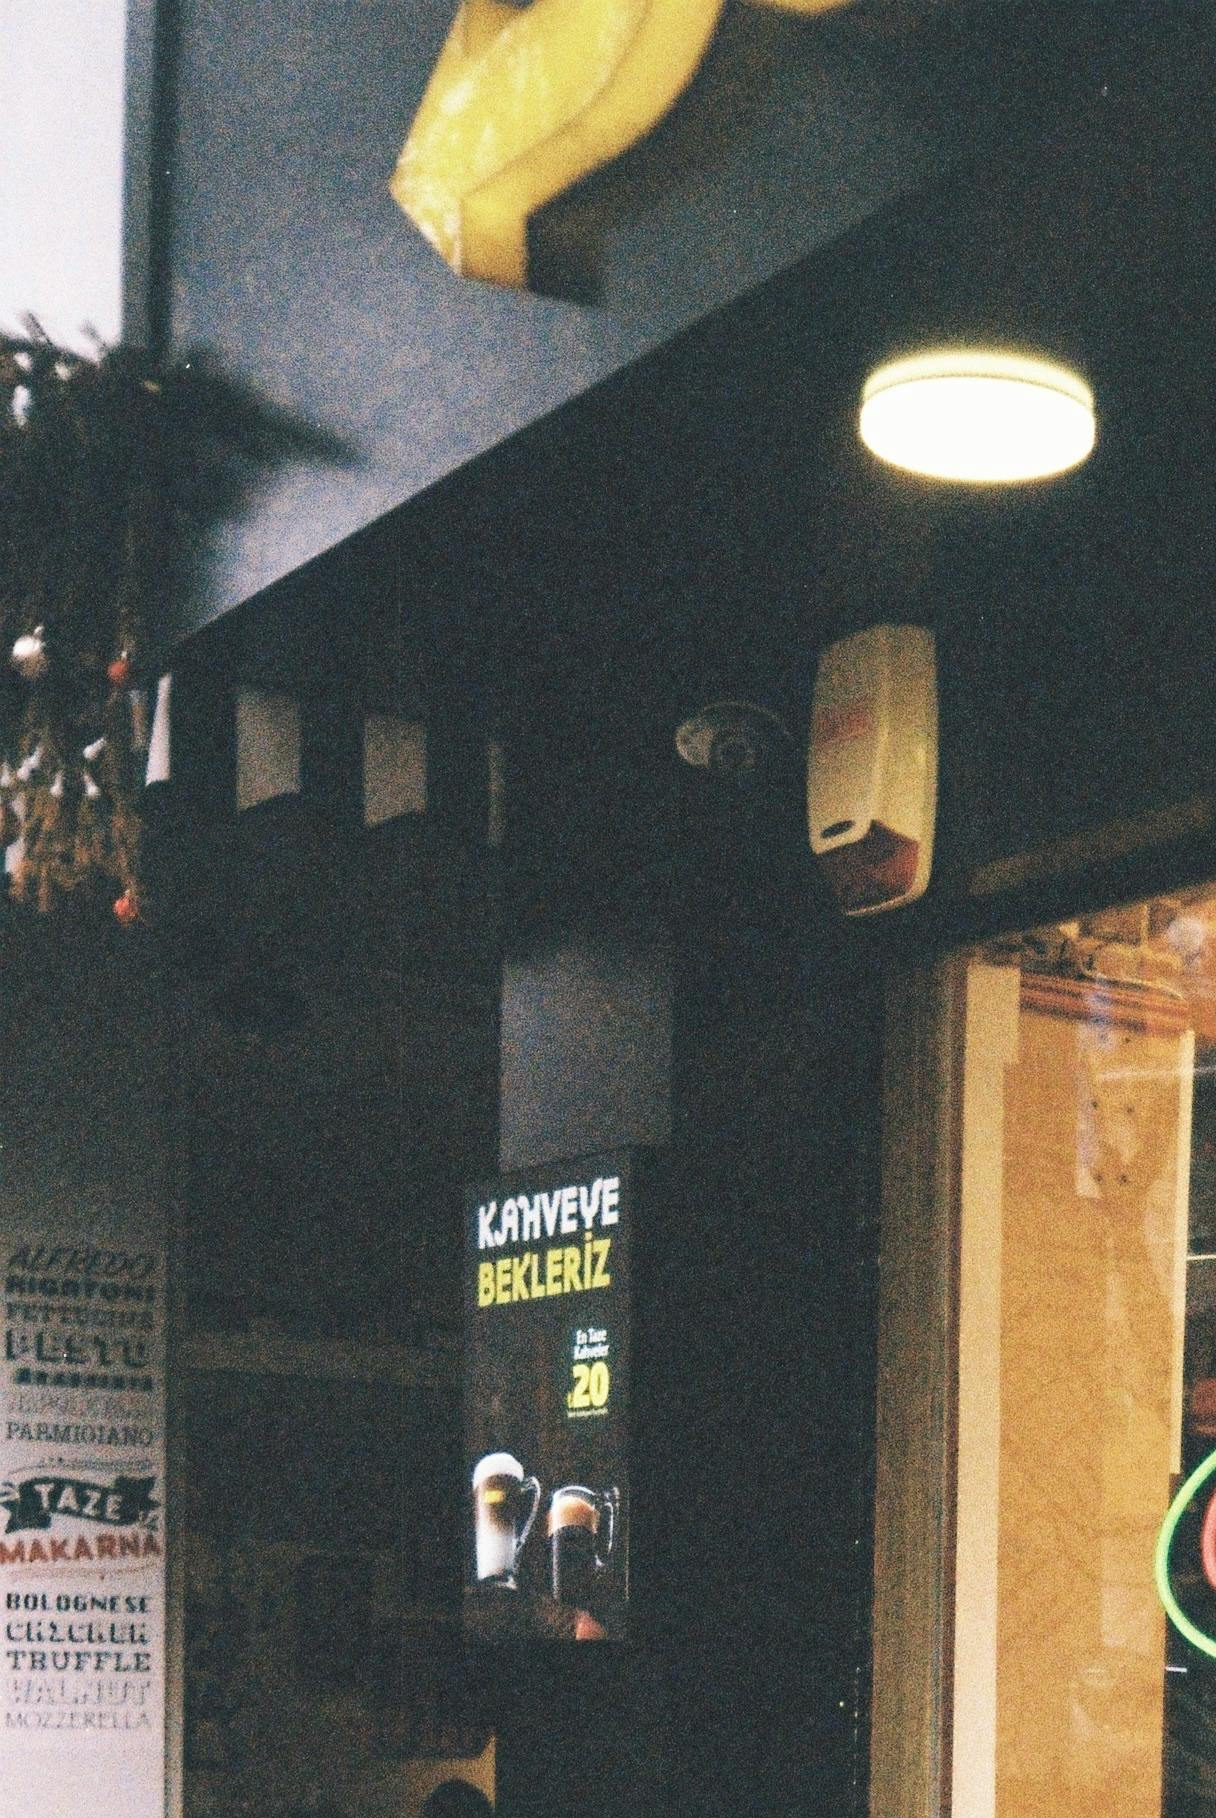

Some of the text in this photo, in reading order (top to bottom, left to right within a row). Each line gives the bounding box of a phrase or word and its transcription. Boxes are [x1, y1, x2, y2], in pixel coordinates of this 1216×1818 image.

[478, 1177, 620, 1249] KAHVEYE
[477, 1232, 611, 1307] BEKLERİZ
[34, 1484, 122, 1520] TAZE
[0, 1534, 161, 1563] MAKARNA
[6, 1593, 150, 1613] BOLOGNESE
[6, 1651, 151, 1672] TRUFFLE
